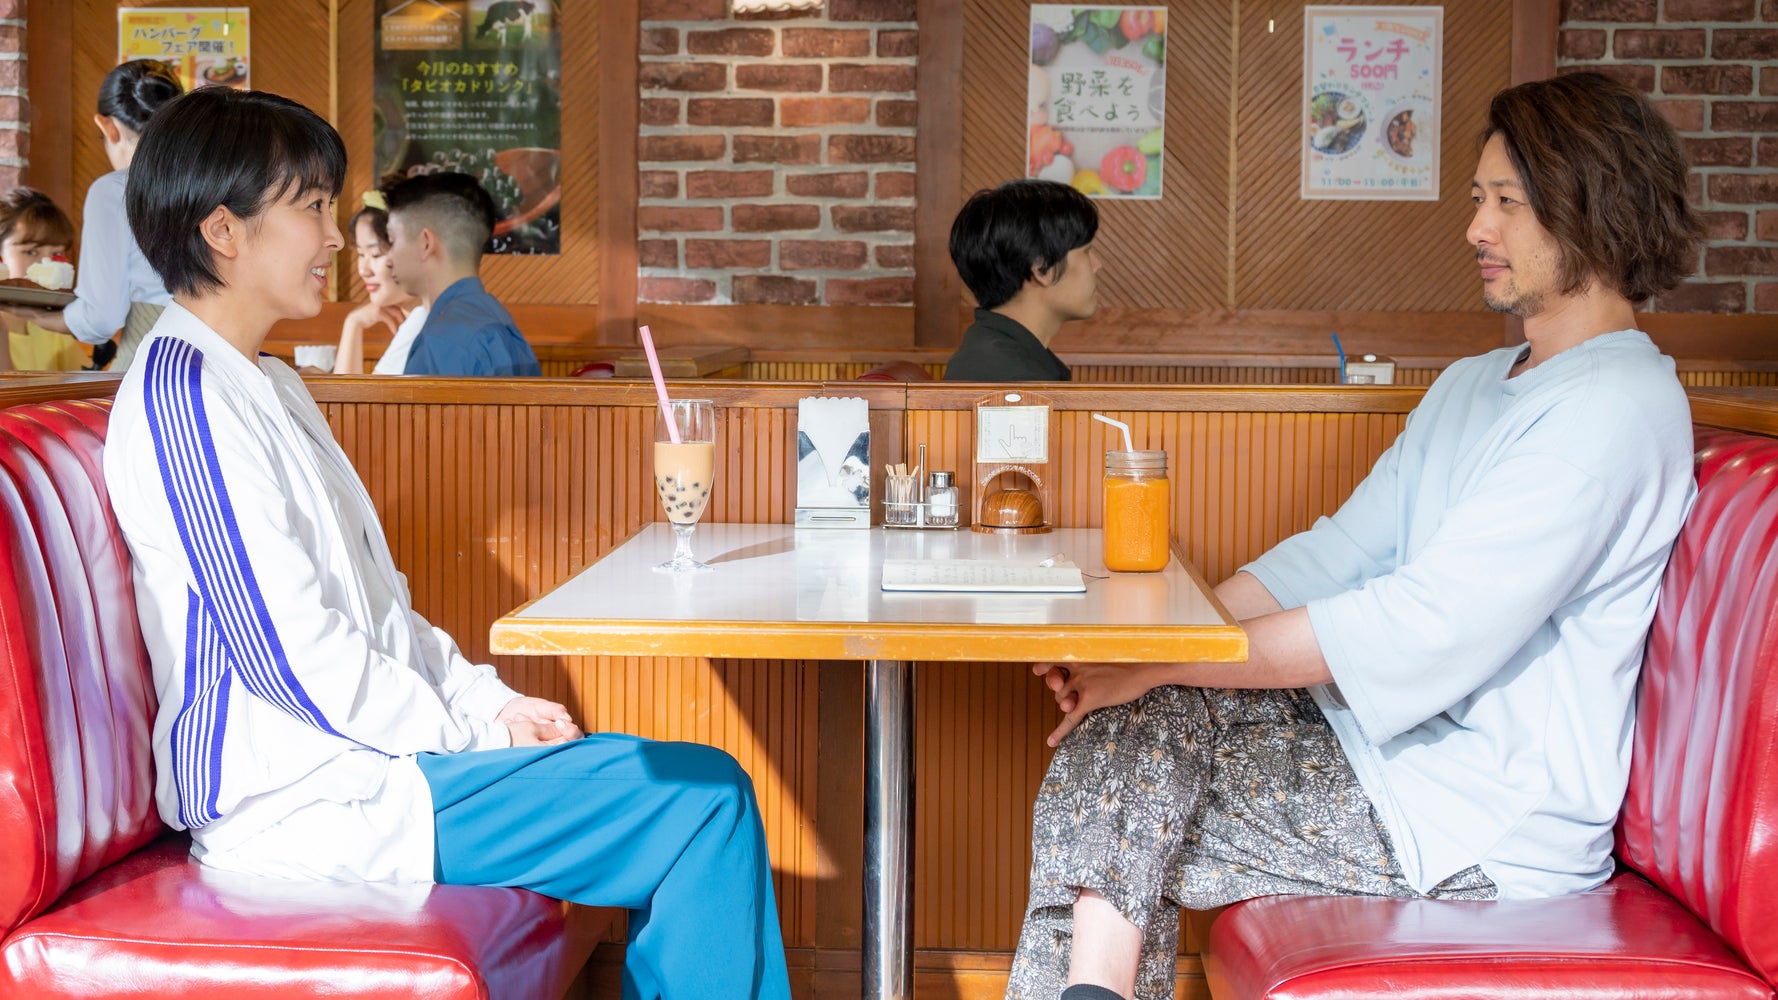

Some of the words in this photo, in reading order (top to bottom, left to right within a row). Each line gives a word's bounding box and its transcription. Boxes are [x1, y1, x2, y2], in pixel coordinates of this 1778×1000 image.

[132, 24, 203, 41] ハンバーグ
[161, 40, 234, 53] フェア開催！
[1336, 38, 1411, 63] ランチ
[416, 60, 519, 77] 今月のおすすめ
[1350, 64, 1399, 79] 500円
[1061, 70, 1134, 97] 野菜を
[1054, 97, 1142, 124] 食べよう
